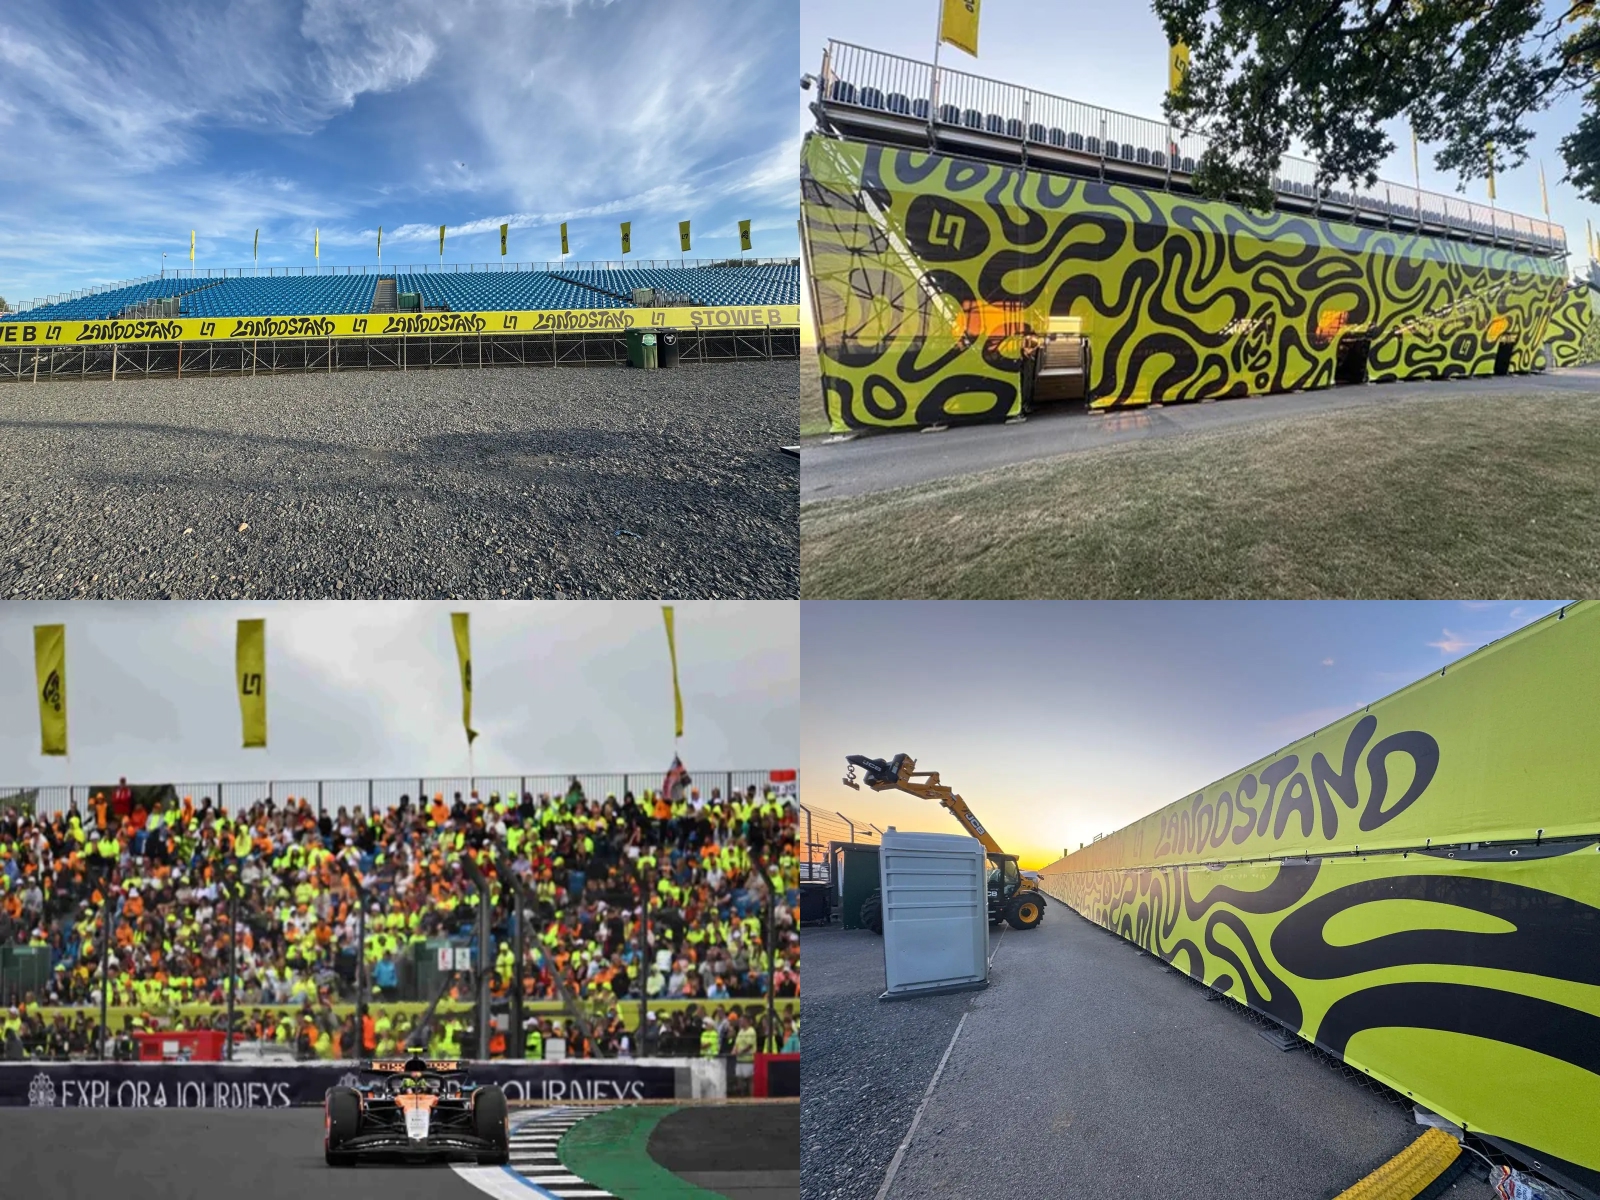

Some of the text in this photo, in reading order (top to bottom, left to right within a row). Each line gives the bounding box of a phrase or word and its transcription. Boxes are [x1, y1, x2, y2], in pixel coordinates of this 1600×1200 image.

[0, 326, 17, 342] E
[23, 325, 37, 342] B
[76, 321, 183, 341] LANDOSTAND
[230, 317, 336, 338] LANDOSTAND
[383, 313, 487, 333] LANDOSTAND
[533, 310, 635, 330] LANDOSTAND
[690, 309, 764, 326] STOWE
[767, 308, 782, 325] B
[862, 760, 882, 772] JCB
[1154, 714, 1440, 859] LANDOSTAND
[965, 814, 985, 835] JCB
[987, 890, 998, 898] CB
[494, 1079, 645, 1102] OURNEYS
